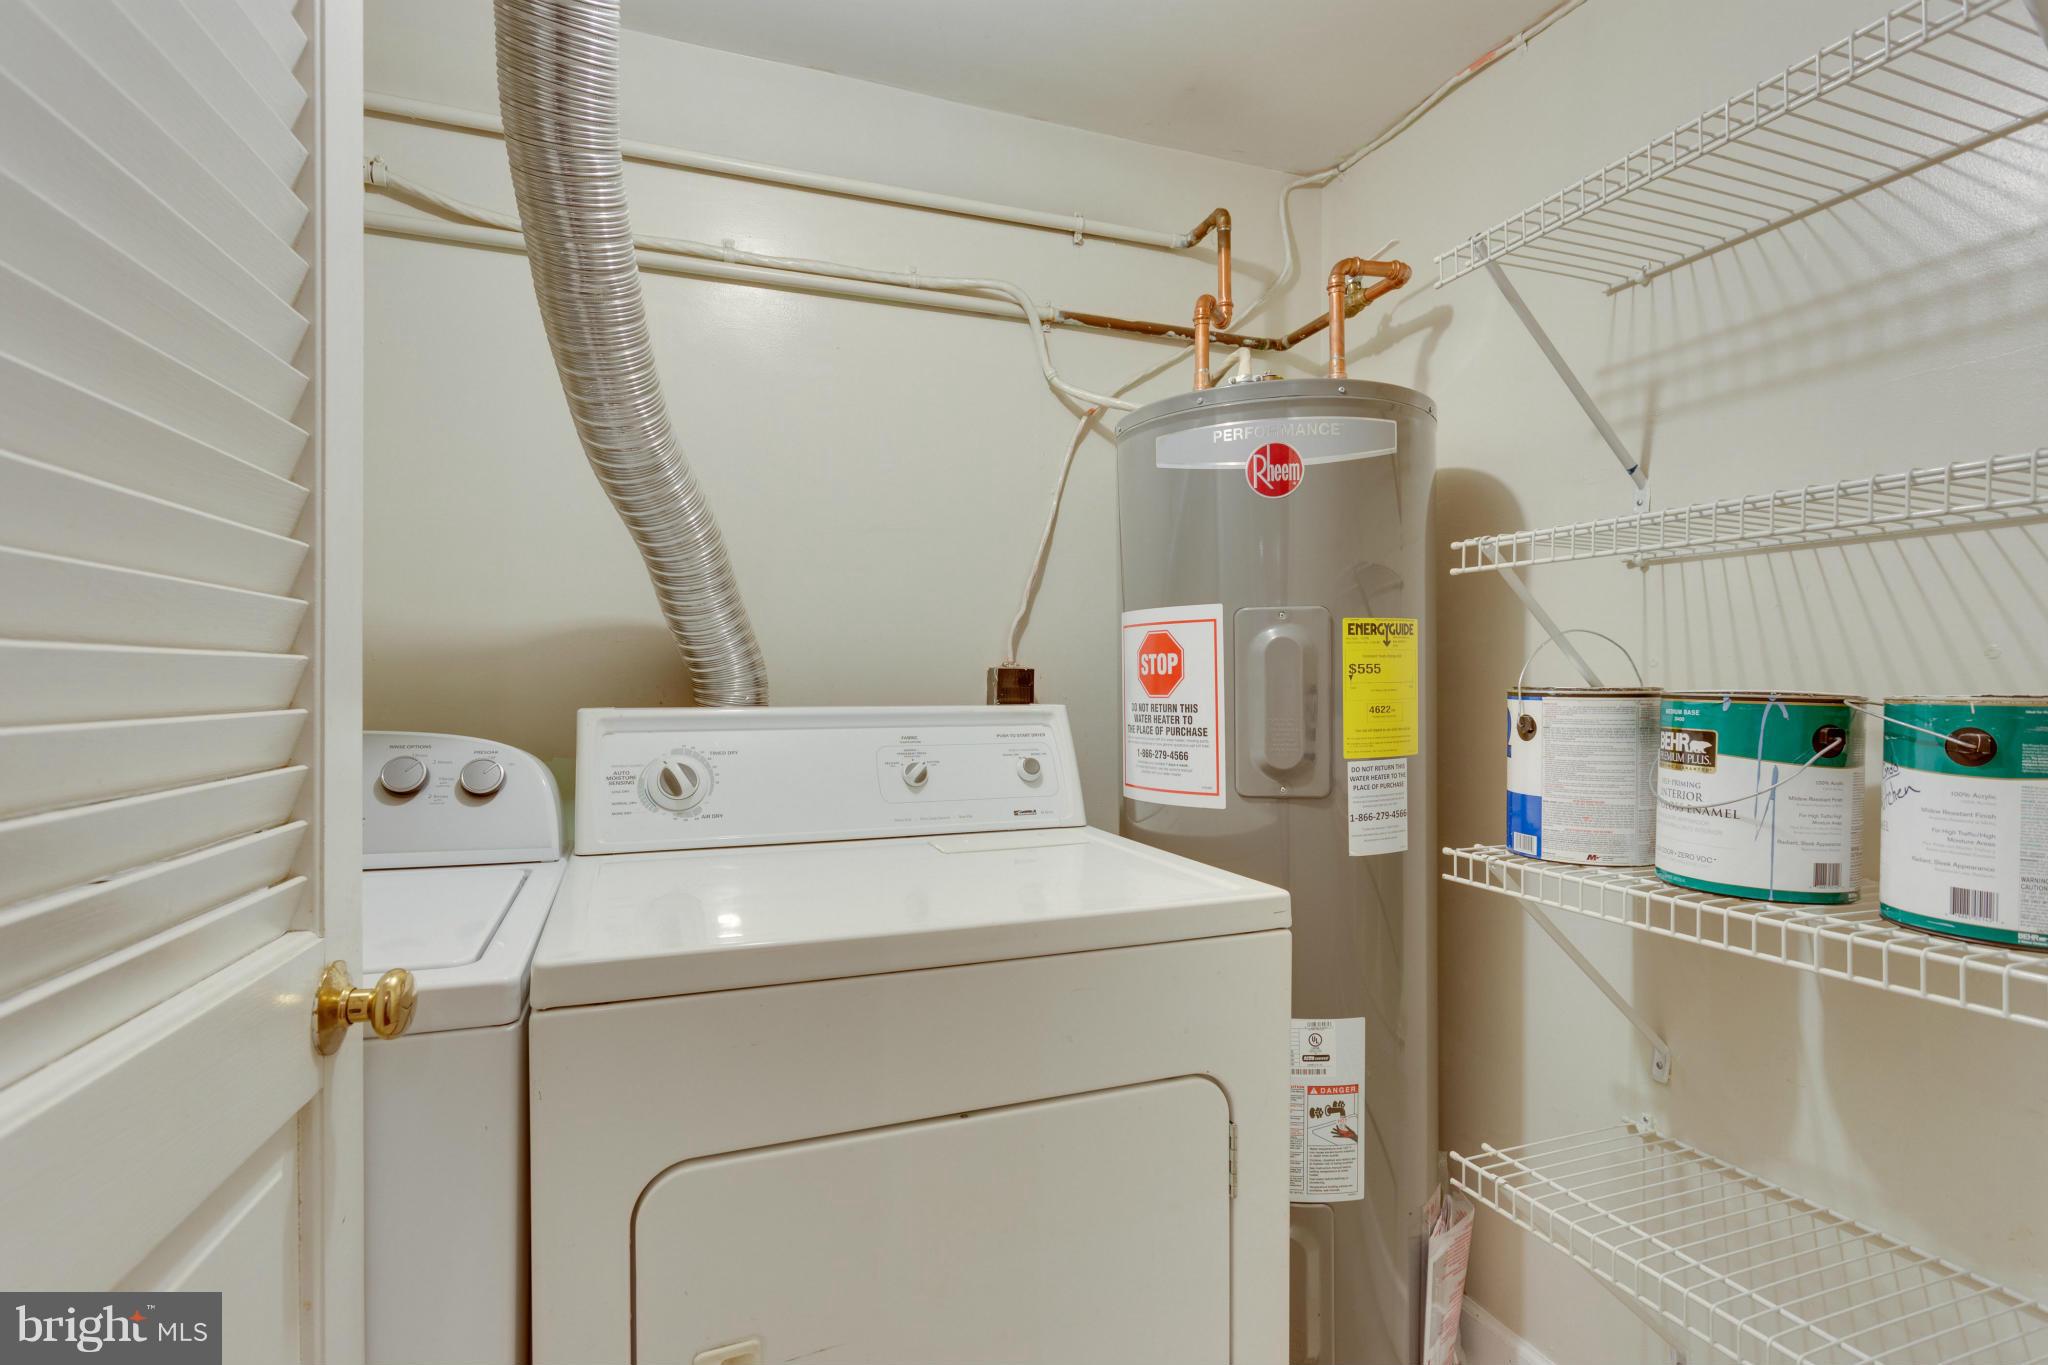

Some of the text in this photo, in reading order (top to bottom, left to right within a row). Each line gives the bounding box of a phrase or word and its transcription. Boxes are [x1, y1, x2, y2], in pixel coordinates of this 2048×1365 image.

[1253, 444, 1300, 490] Rheem
[1347, 622, 1414, 636] ENERGYGUIDE
[1141, 653, 1179, 676] STOP
[1348, 663, 1381, 675] $555
[1139, 703, 1149, 712] NOT
[1151, 704, 1178, 713] RETURN
[1180, 704, 1199, 713] THIS
[1134, 714, 1193, 725] WATER HEATER TO
[1128, 725, 1208, 737] THE PLACE OF PURCHASE
[1660, 730, 1690, 752] BEHR
[1138, 748, 1189, 761] 1-866-279-4566
[1687, 752, 1711, 766] PLUS
[1380, 781, 1404, 789] PURCHASE
[1350, 809, 1407, 822] 1-866-279-4566
[1320, 1086, 1357, 1095] DANGER
